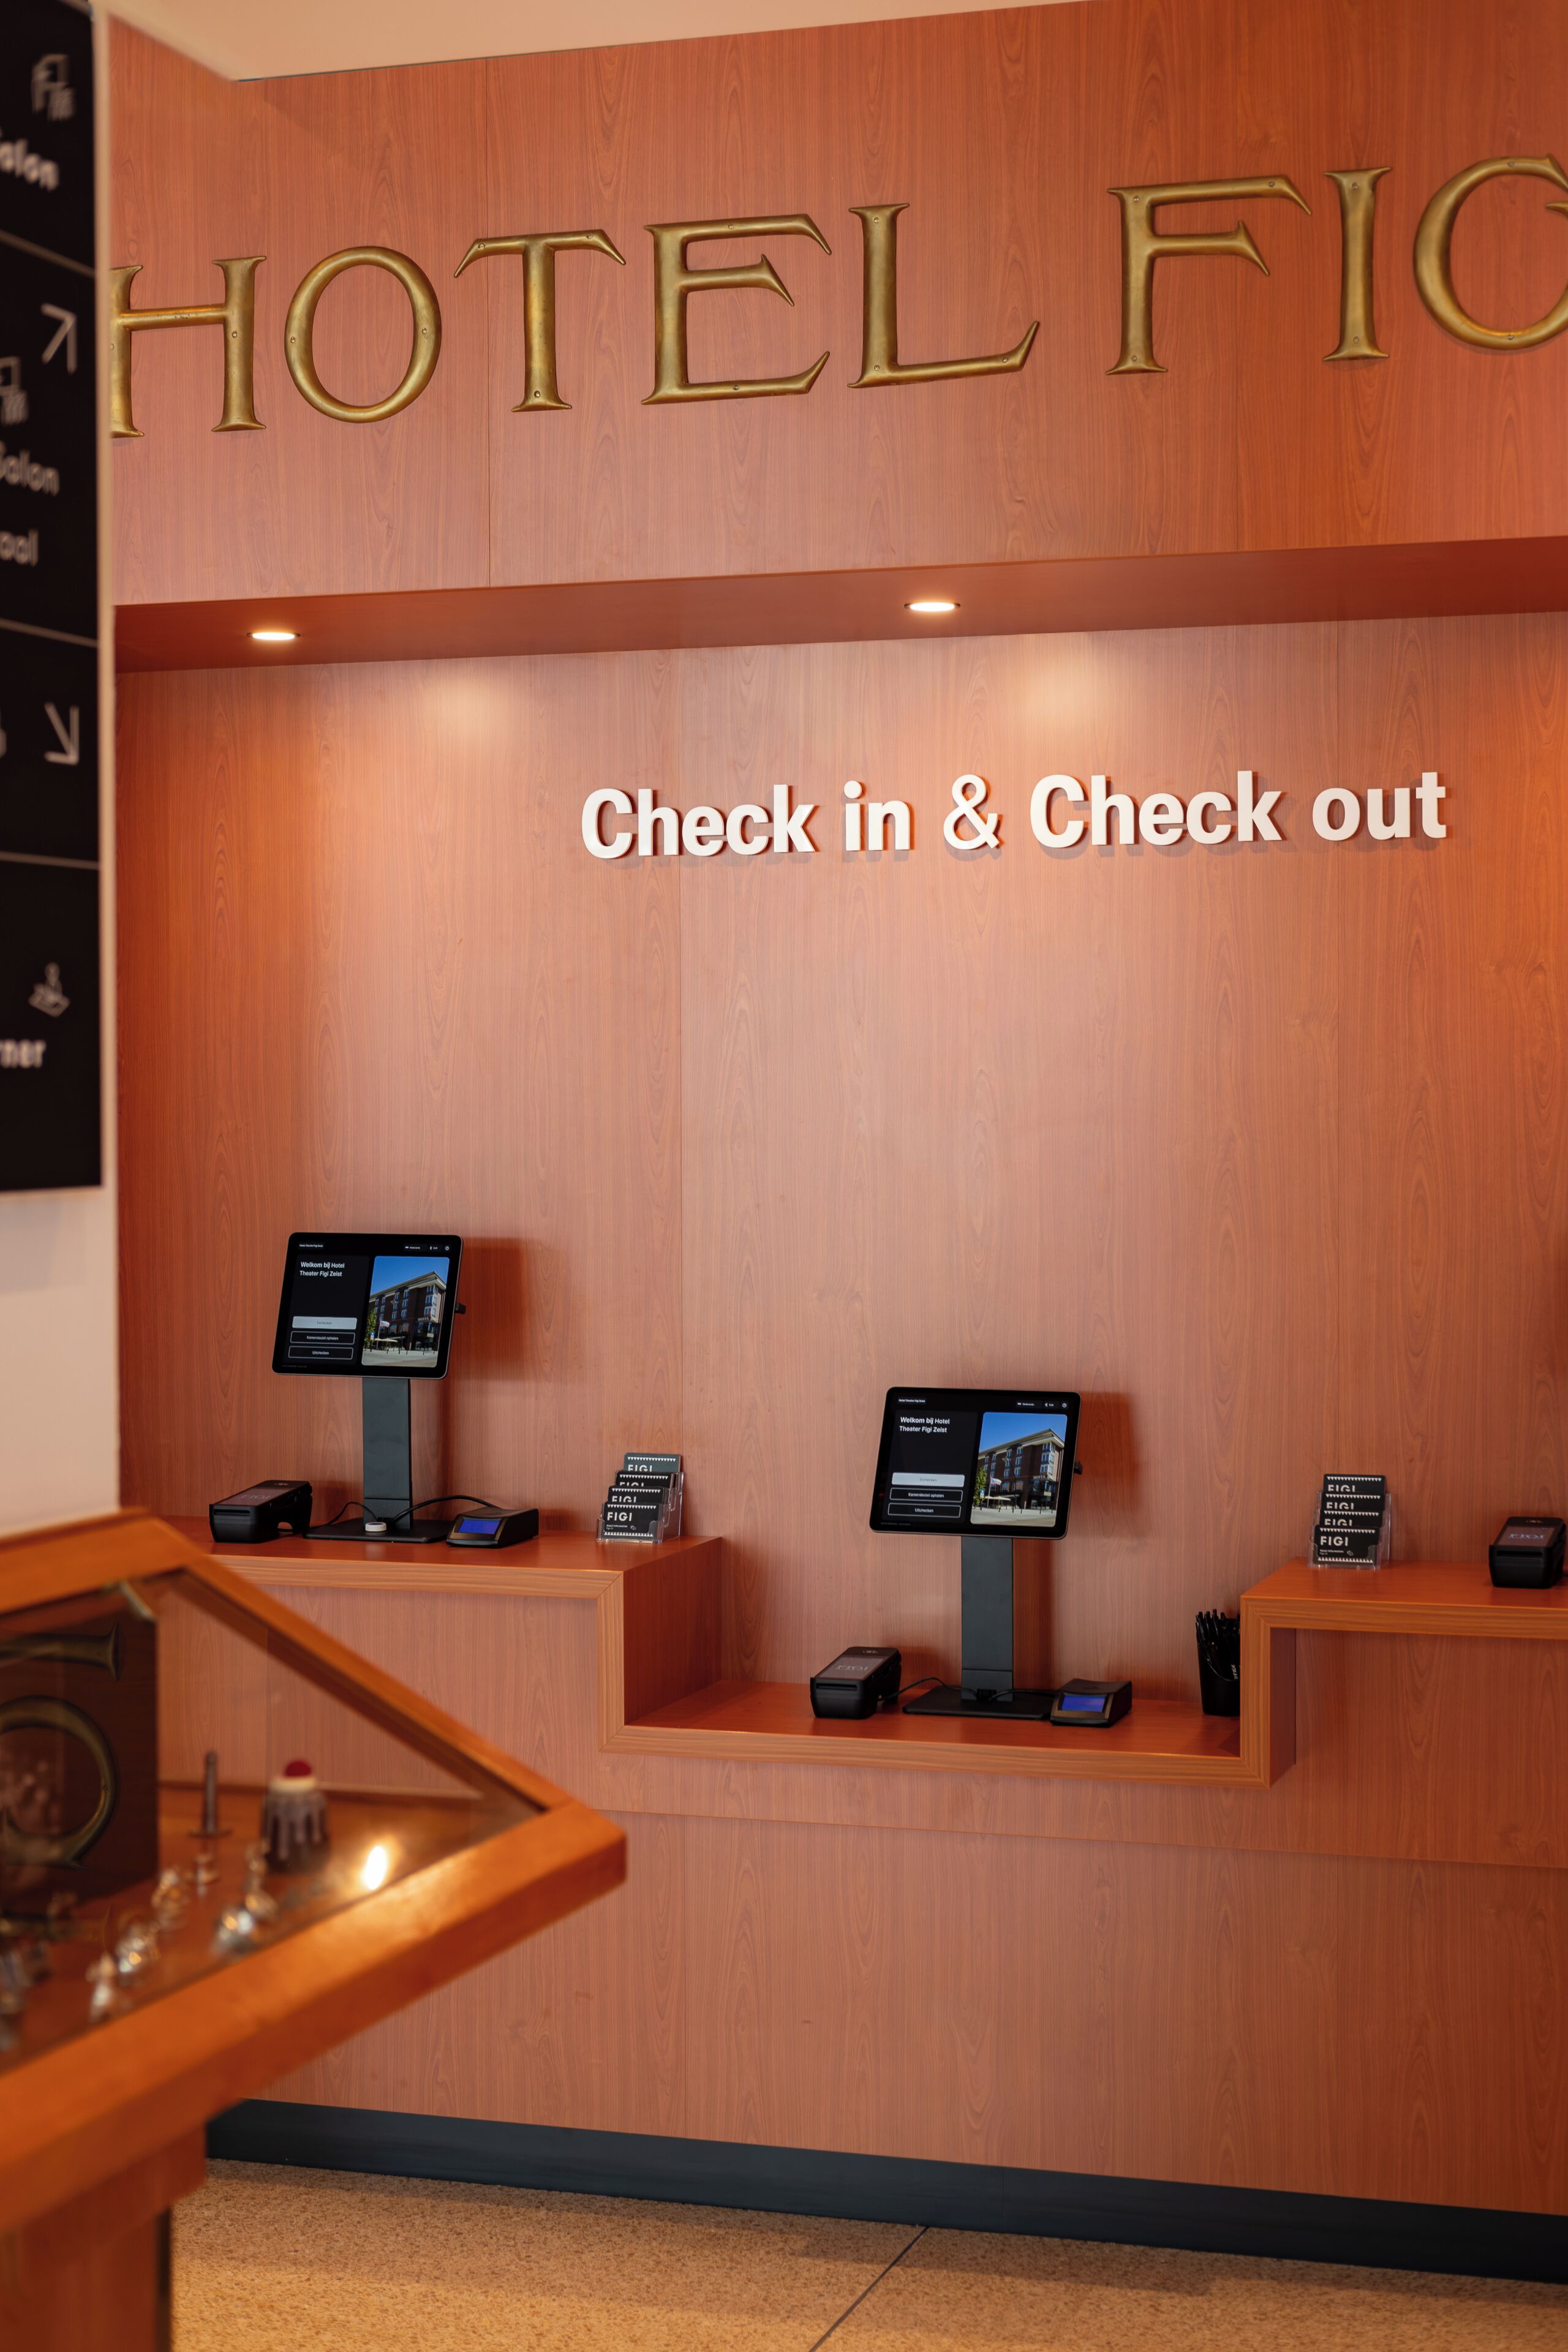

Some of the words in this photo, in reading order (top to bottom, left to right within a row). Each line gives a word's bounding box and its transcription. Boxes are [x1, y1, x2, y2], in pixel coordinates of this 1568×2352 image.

[0, 139, 59, 192] alon
[111, 203, 1038, 439] HOTEL
[581, 784, 815, 859] Check
[843, 781, 910, 851] in
[943, 774, 1001, 850] &
[1030, 770, 1284, 848] Check
[1312, 771, 1446, 840] out
[0, 1039, 47, 1069] ner
[607, 1512, 632, 1521] FIGI
[1320, 1536, 1349, 1547] FIGI
